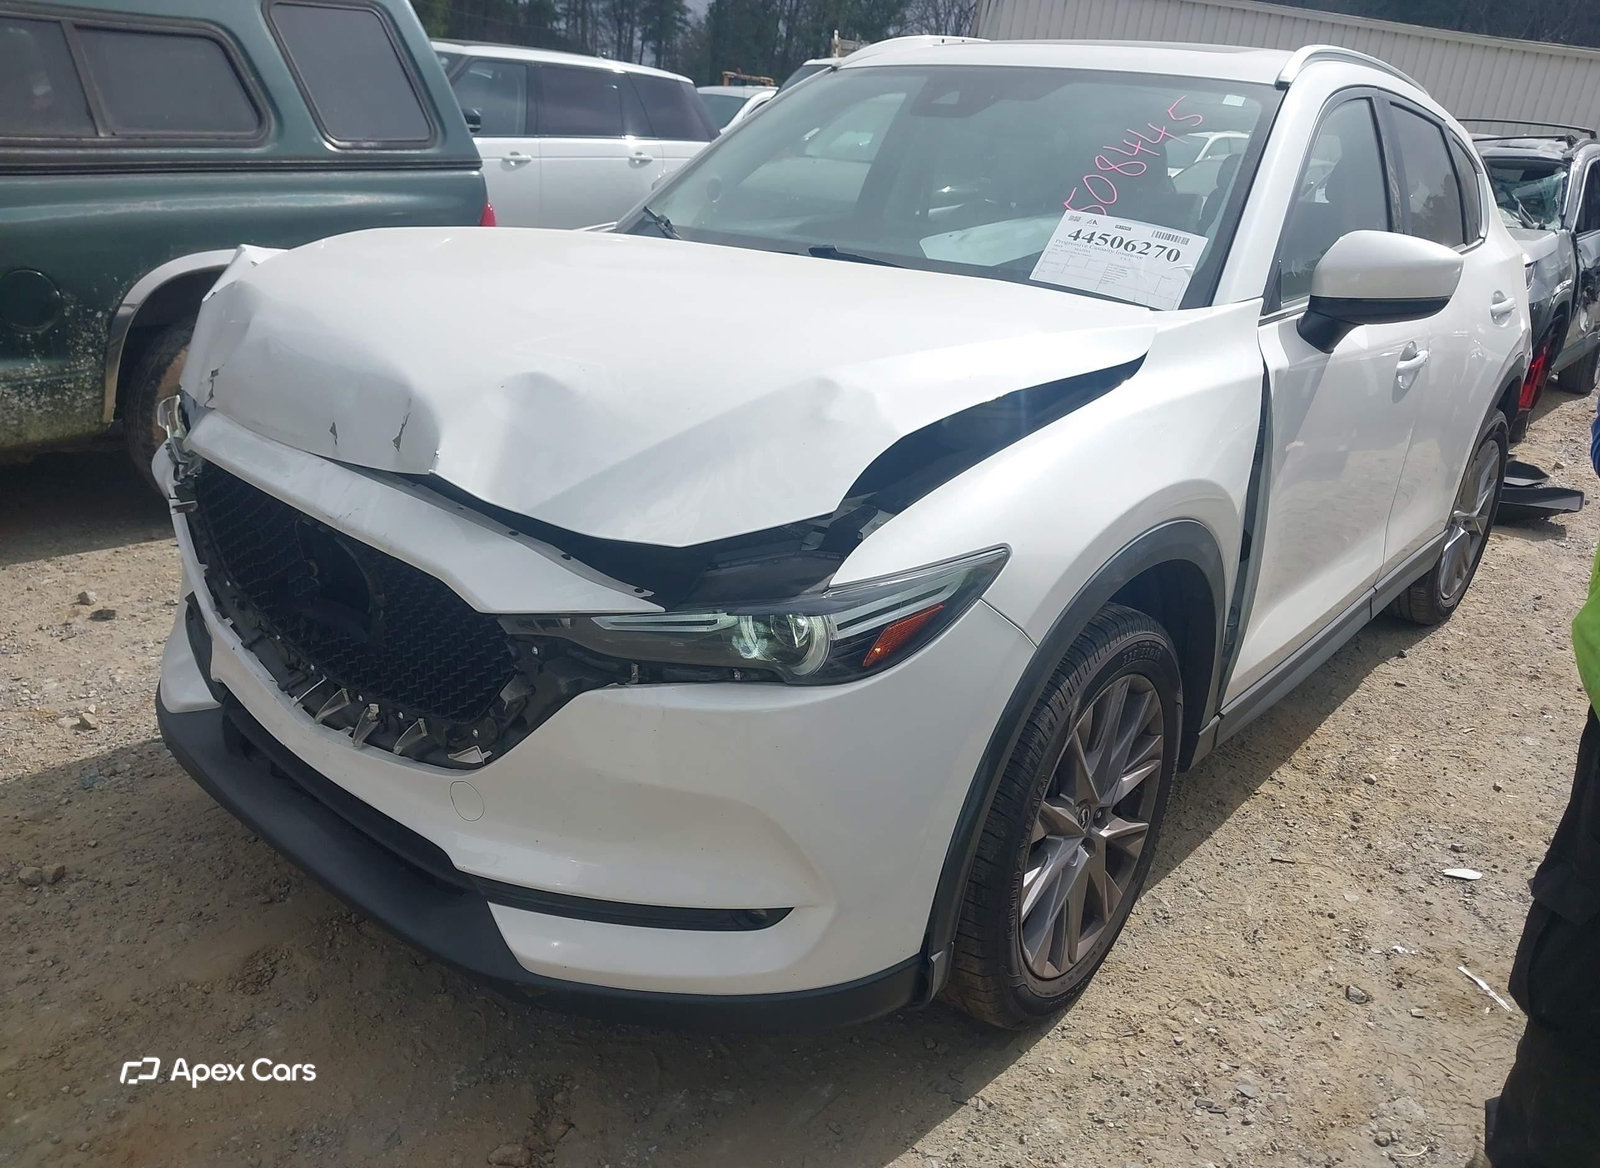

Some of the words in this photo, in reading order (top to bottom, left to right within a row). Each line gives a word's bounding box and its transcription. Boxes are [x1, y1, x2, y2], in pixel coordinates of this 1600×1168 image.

[1063, 94, 1203, 216] 508445
[1055, 239, 1089, 249] Progressive
[1067, 228, 1181, 263] 44506270
